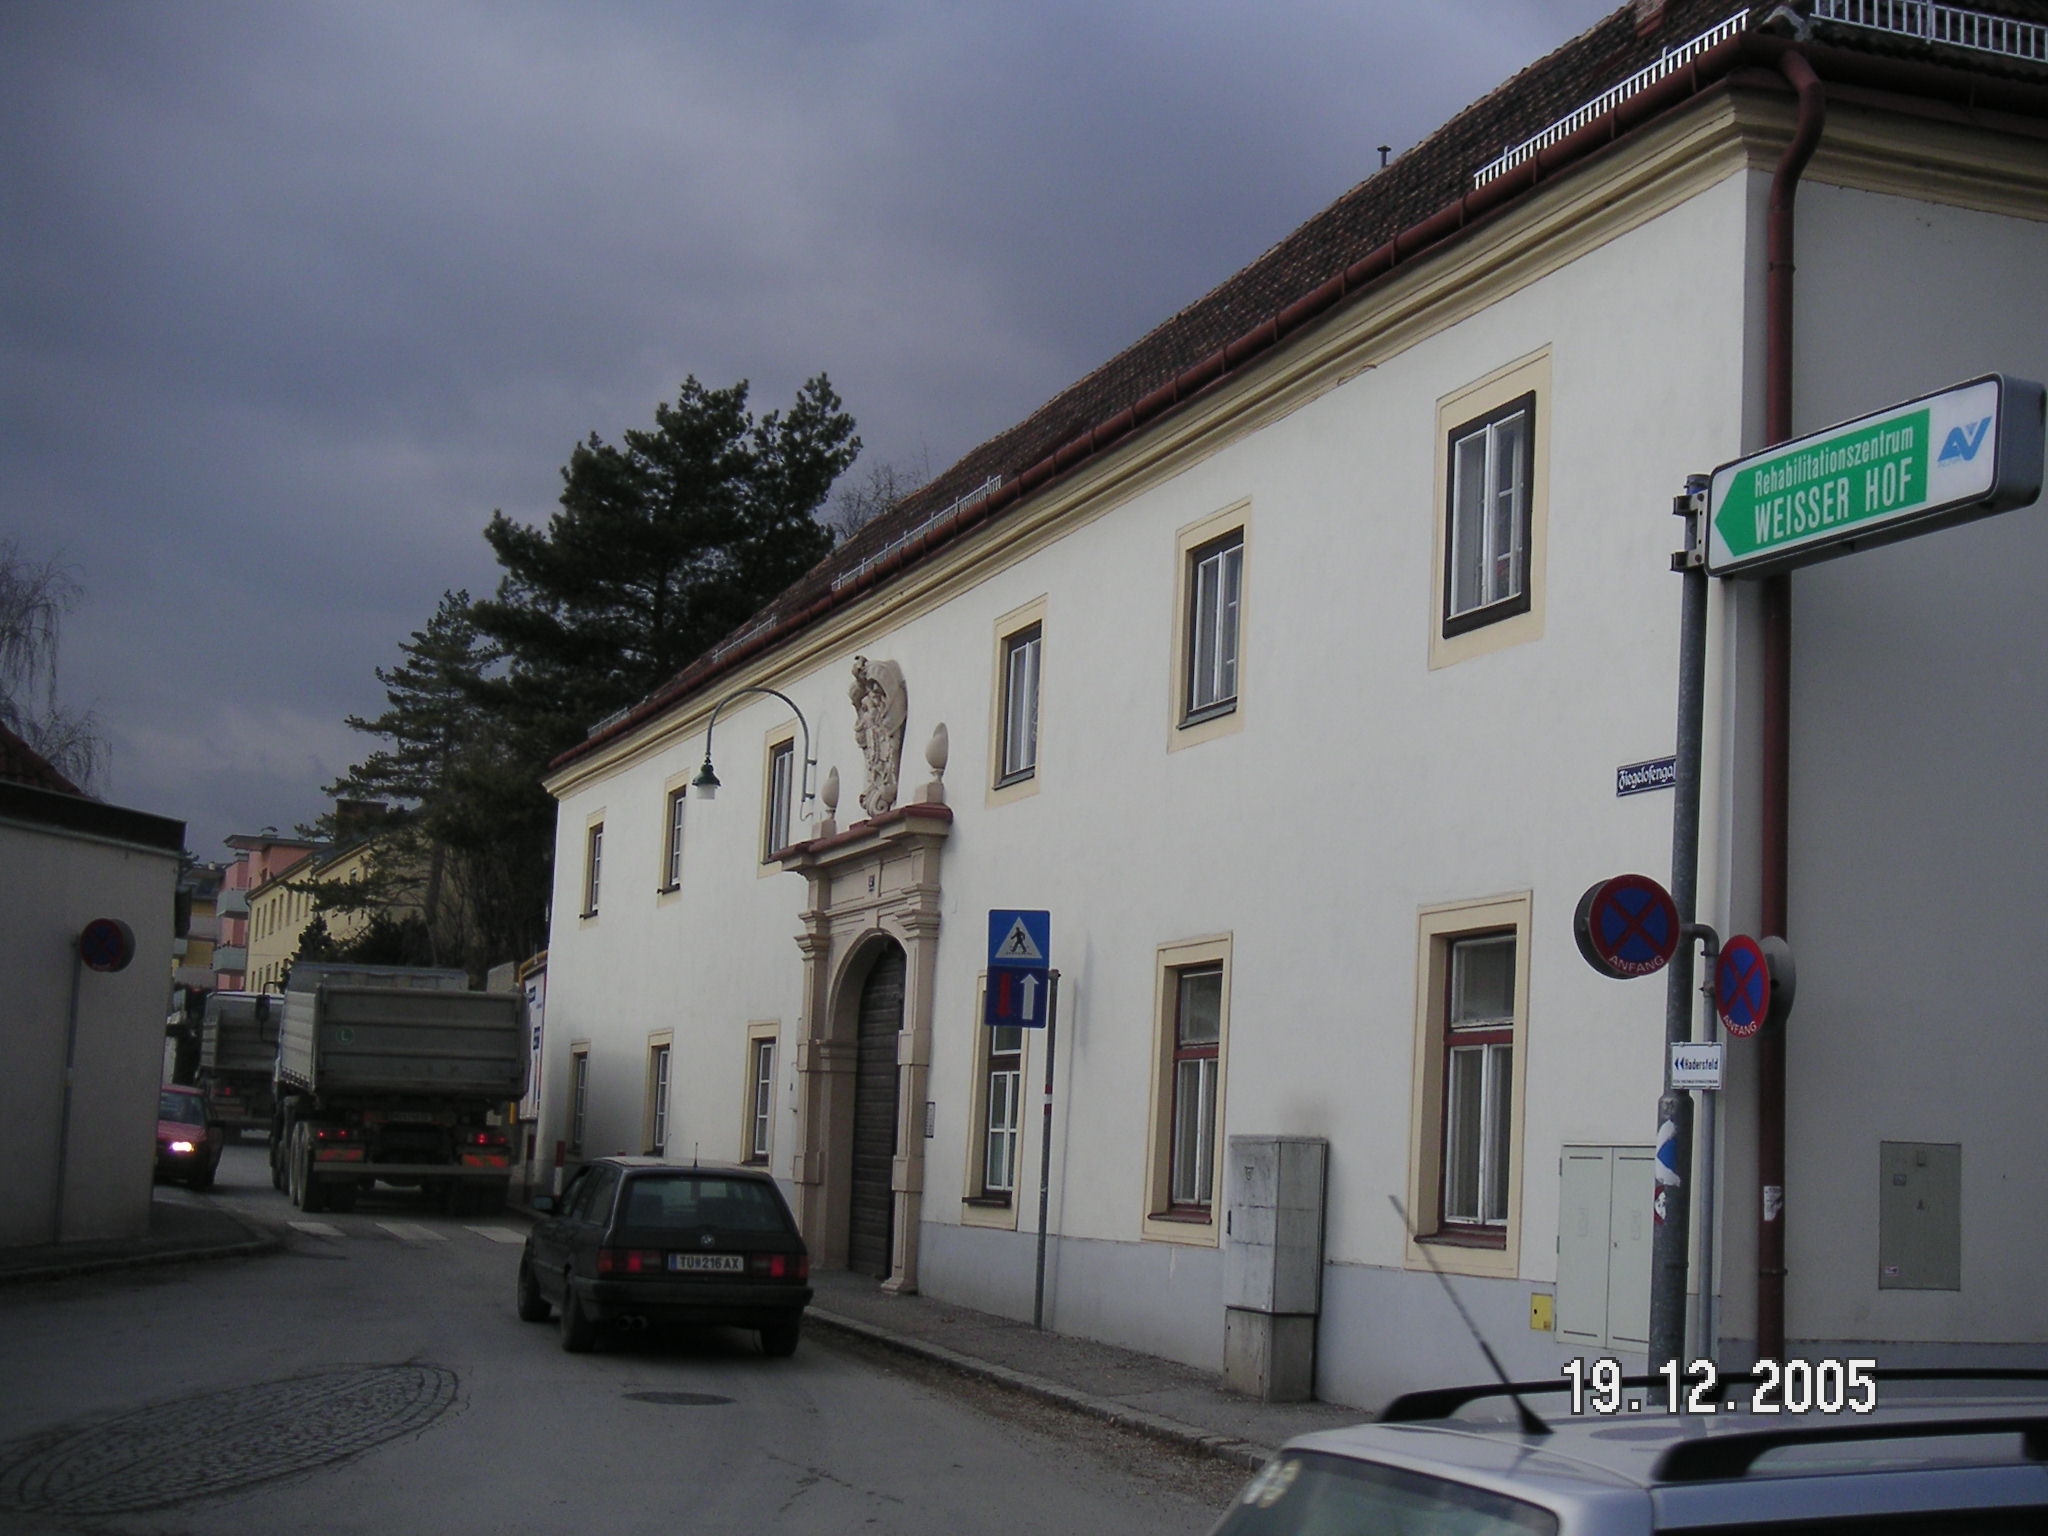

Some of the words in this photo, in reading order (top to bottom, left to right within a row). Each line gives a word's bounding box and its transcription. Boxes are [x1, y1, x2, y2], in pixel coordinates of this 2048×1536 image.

[1754, 426, 1914, 498] Rehabilitationszentrum
[1754, 476, 1849, 545] WEISSER
[1865, 456, 1913, 512] HOF
[1609, 955, 1664, 971] ANFANG
[1722, 1014, 1757, 1036] ANFANG
